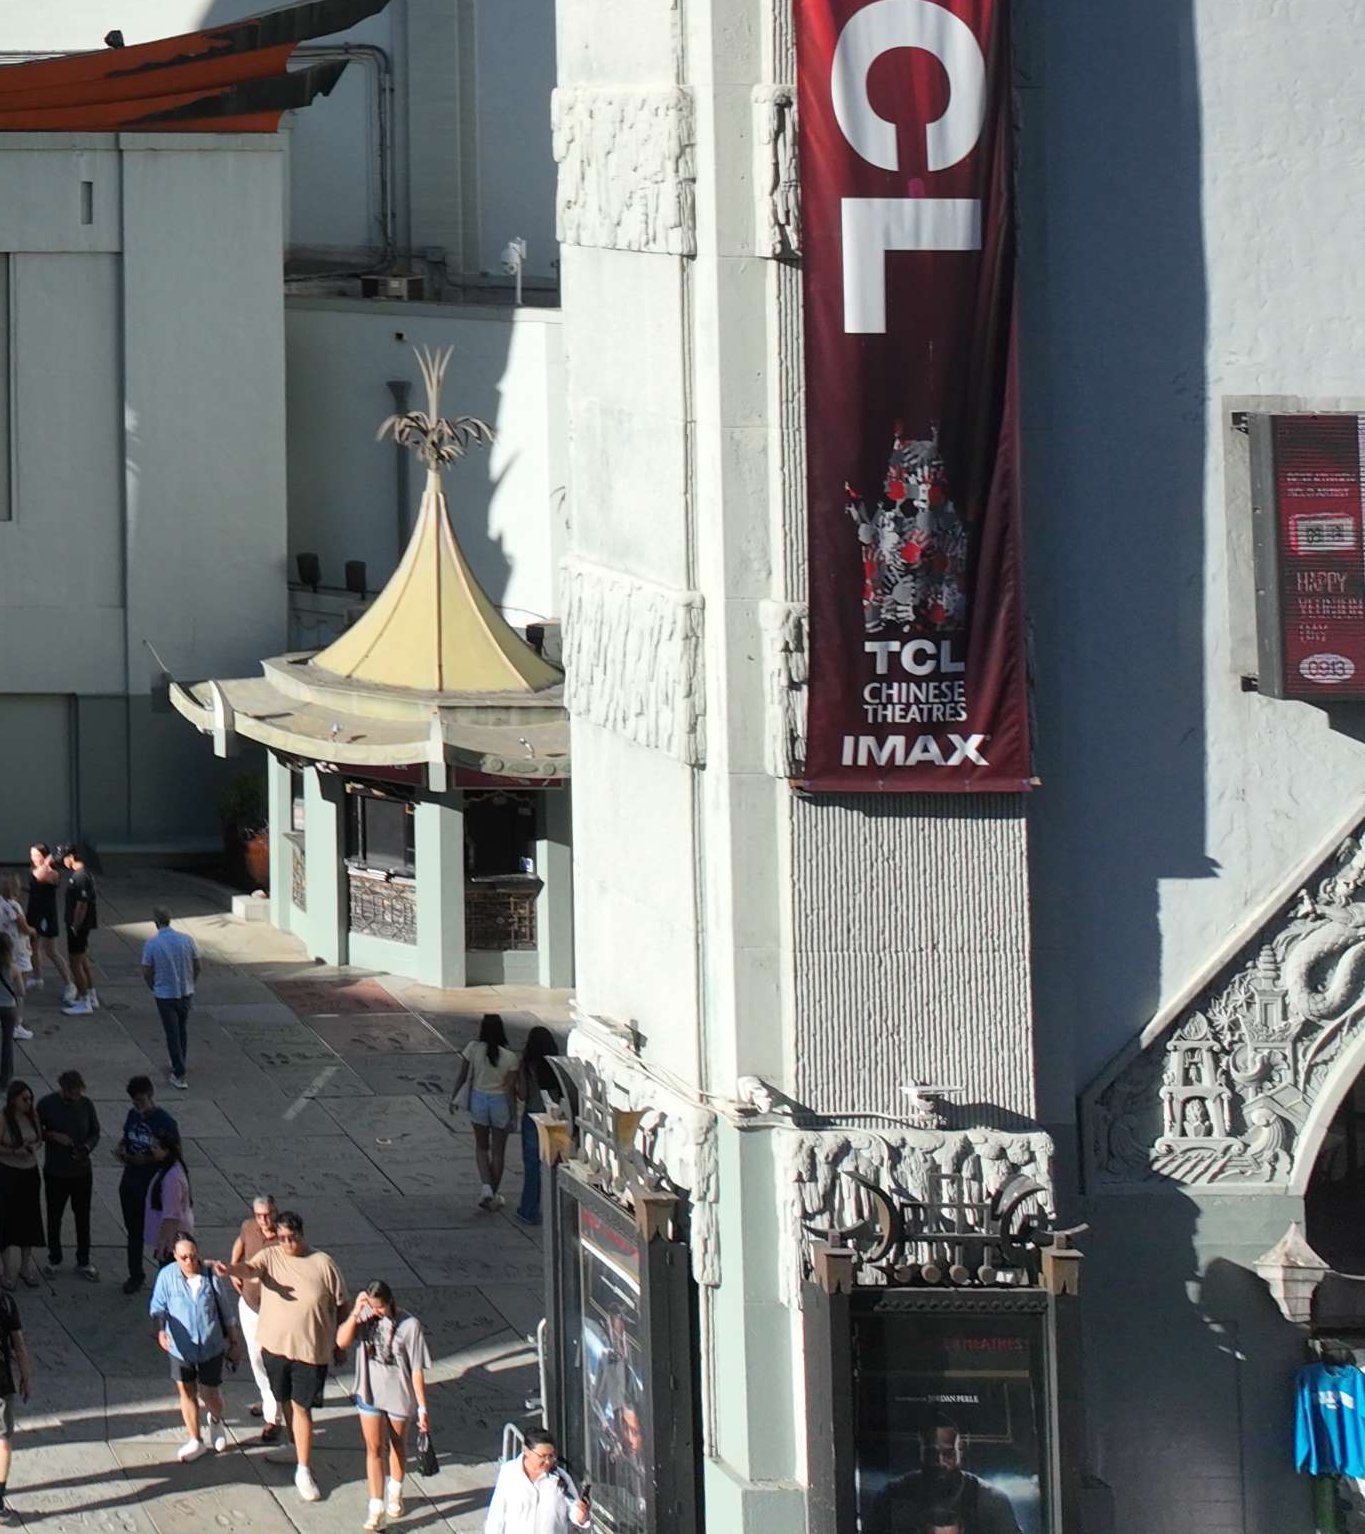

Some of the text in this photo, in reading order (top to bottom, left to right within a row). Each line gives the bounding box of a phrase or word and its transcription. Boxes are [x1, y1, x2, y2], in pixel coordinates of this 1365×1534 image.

[864, 639, 966, 676] TCL
[863, 680, 967, 704] CHINESE
[862, 703, 968, 724] THEATRES
[841, 734, 990, 766] IMAX
